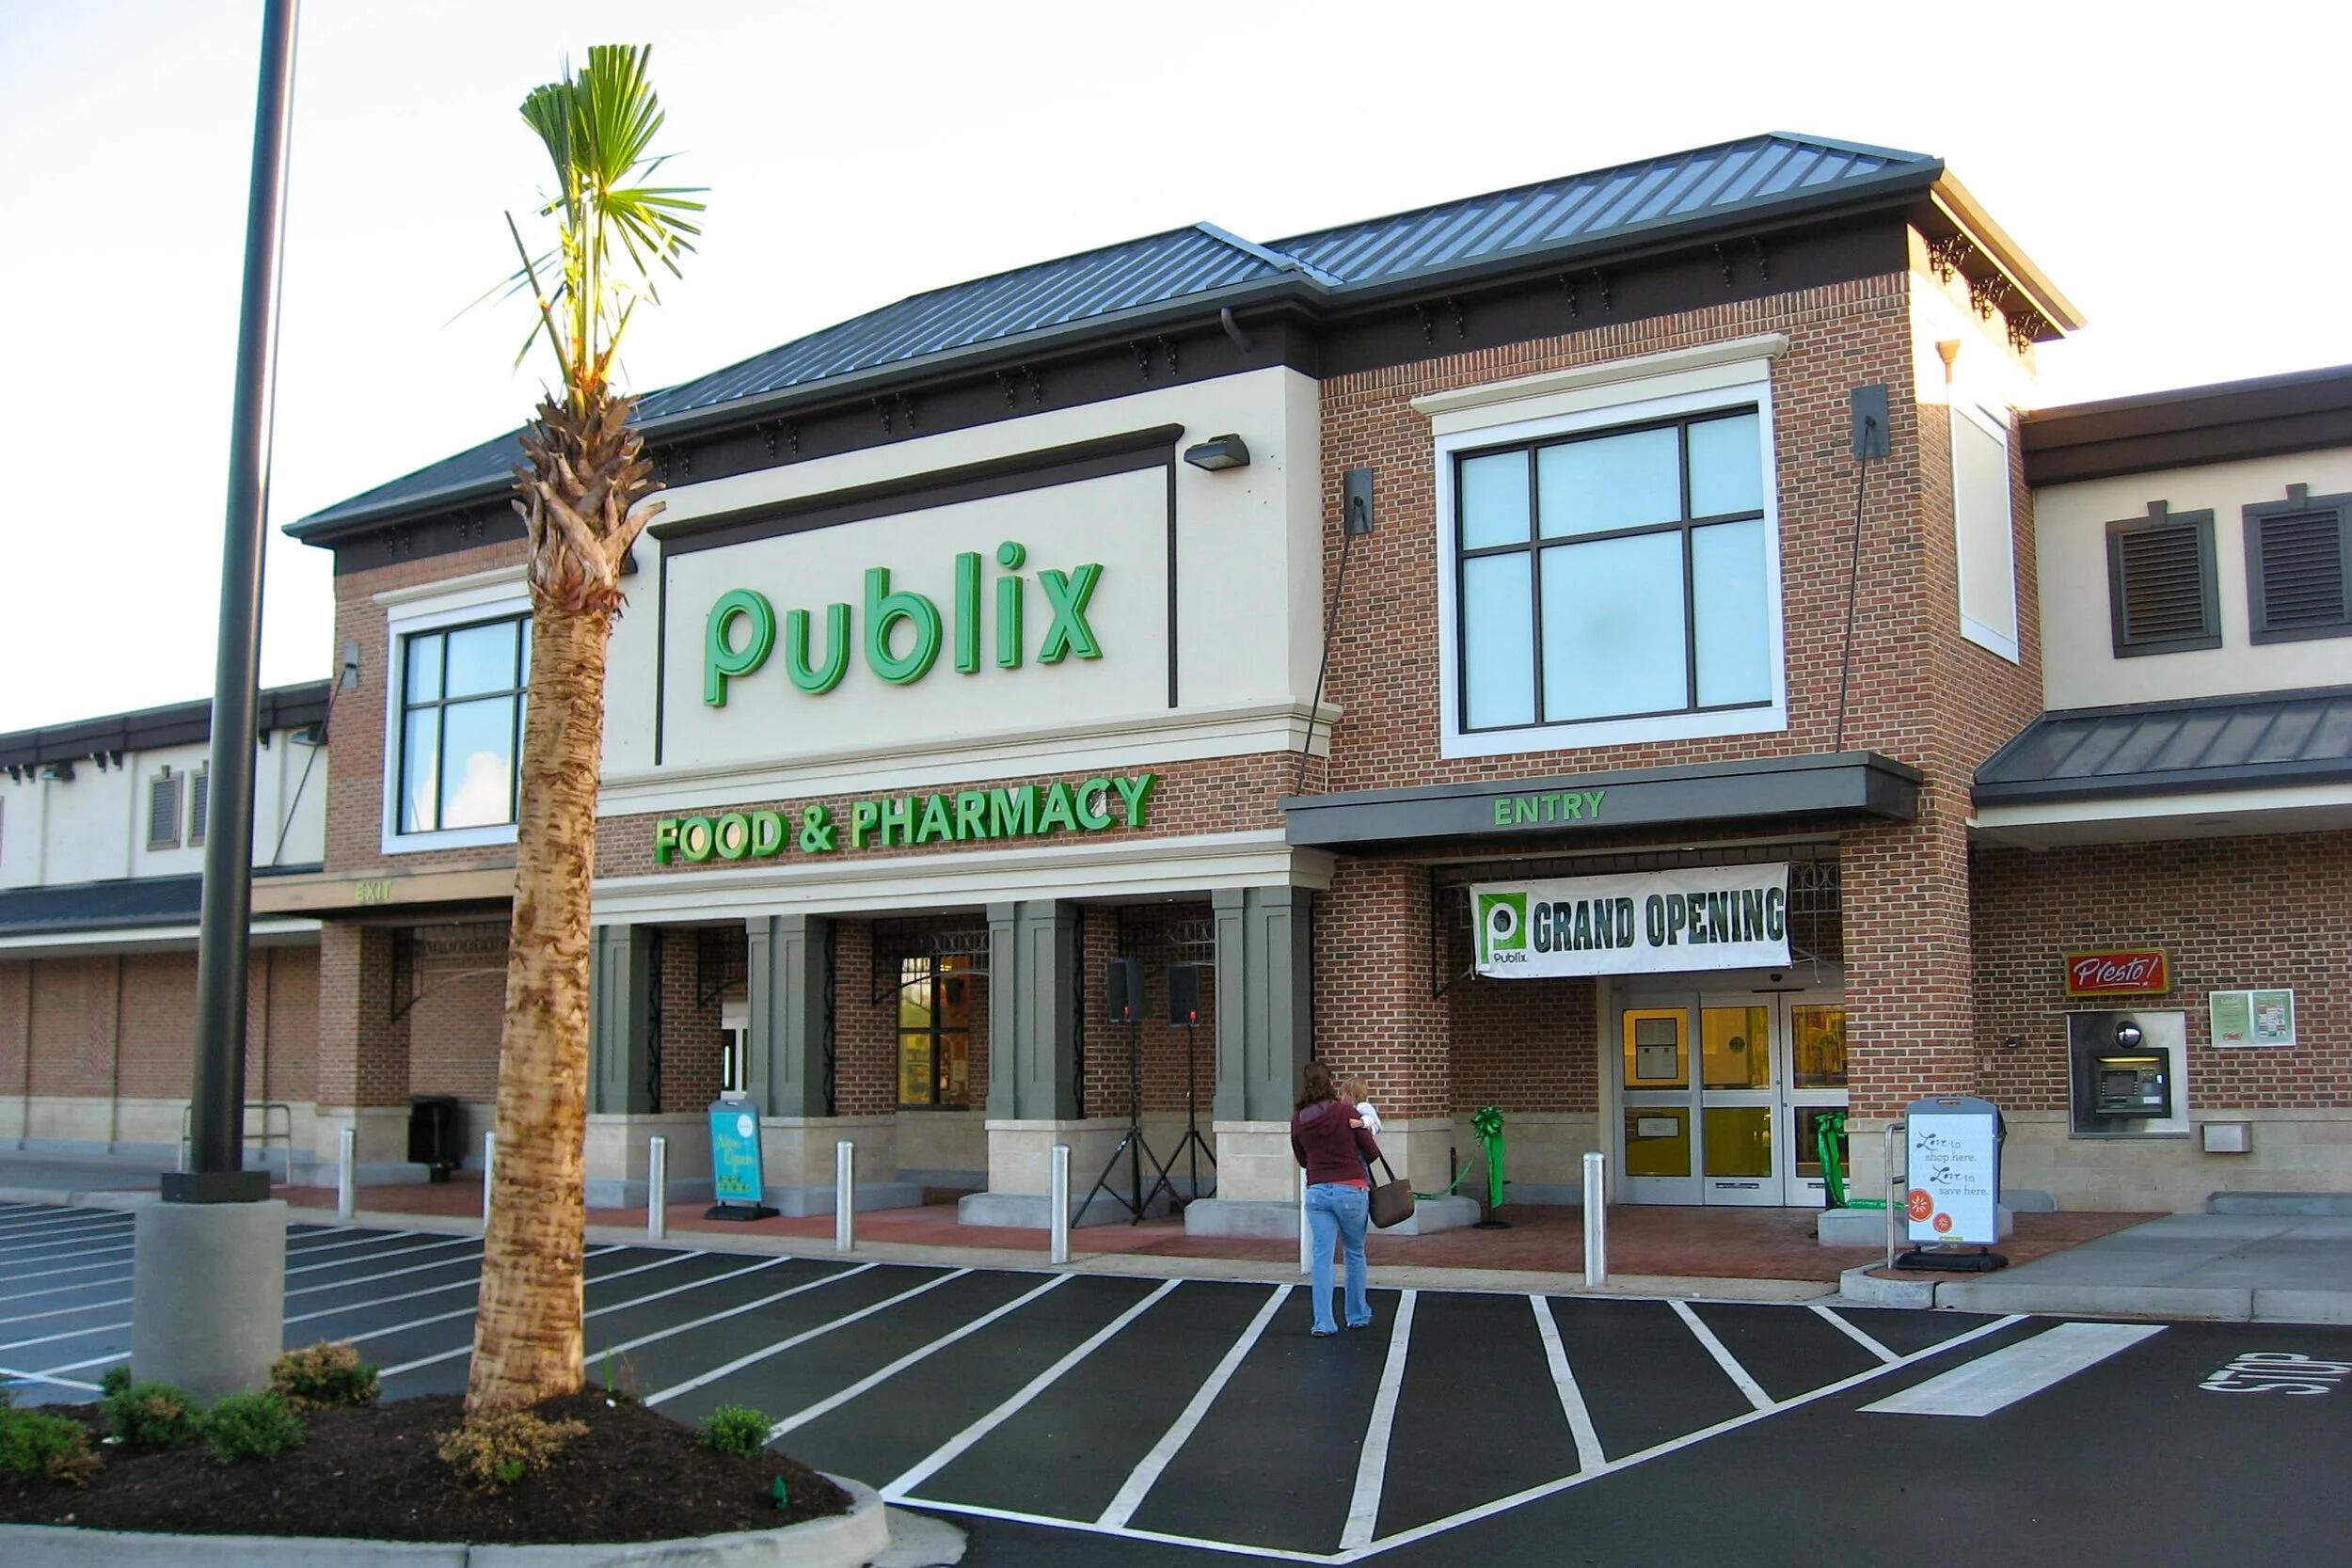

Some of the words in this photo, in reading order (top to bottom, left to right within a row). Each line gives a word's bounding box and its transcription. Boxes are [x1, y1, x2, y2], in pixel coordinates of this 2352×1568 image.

[655, 810, 790, 864] FOOD
[799, 804, 840, 854] &
[850, 773, 1158, 847] PHARMACY
[1494, 790, 1608, 826] ENTRY
[356, 879, 392, 902] EXIT
[1534, 896, 1635, 953] GRAND
[1645, 887, 1785, 947] OPENING
[2074, 956, 2159, 987] Presto!
[1916, 1131, 1947, 1151] Love
[1949, 1140, 1961, 1148] to
[1925, 1151, 1949, 1164] shop
[1951, 1150, 1978, 1162] here.
[1930, 1164, 1961, 1185] Love
[1963, 1174, 1975, 1182] to
[1938, 1187, 1962, 1196] save
[1963, 1185, 1990, 1196] here.
[2198, 1352, 2352, 1395] STOP
